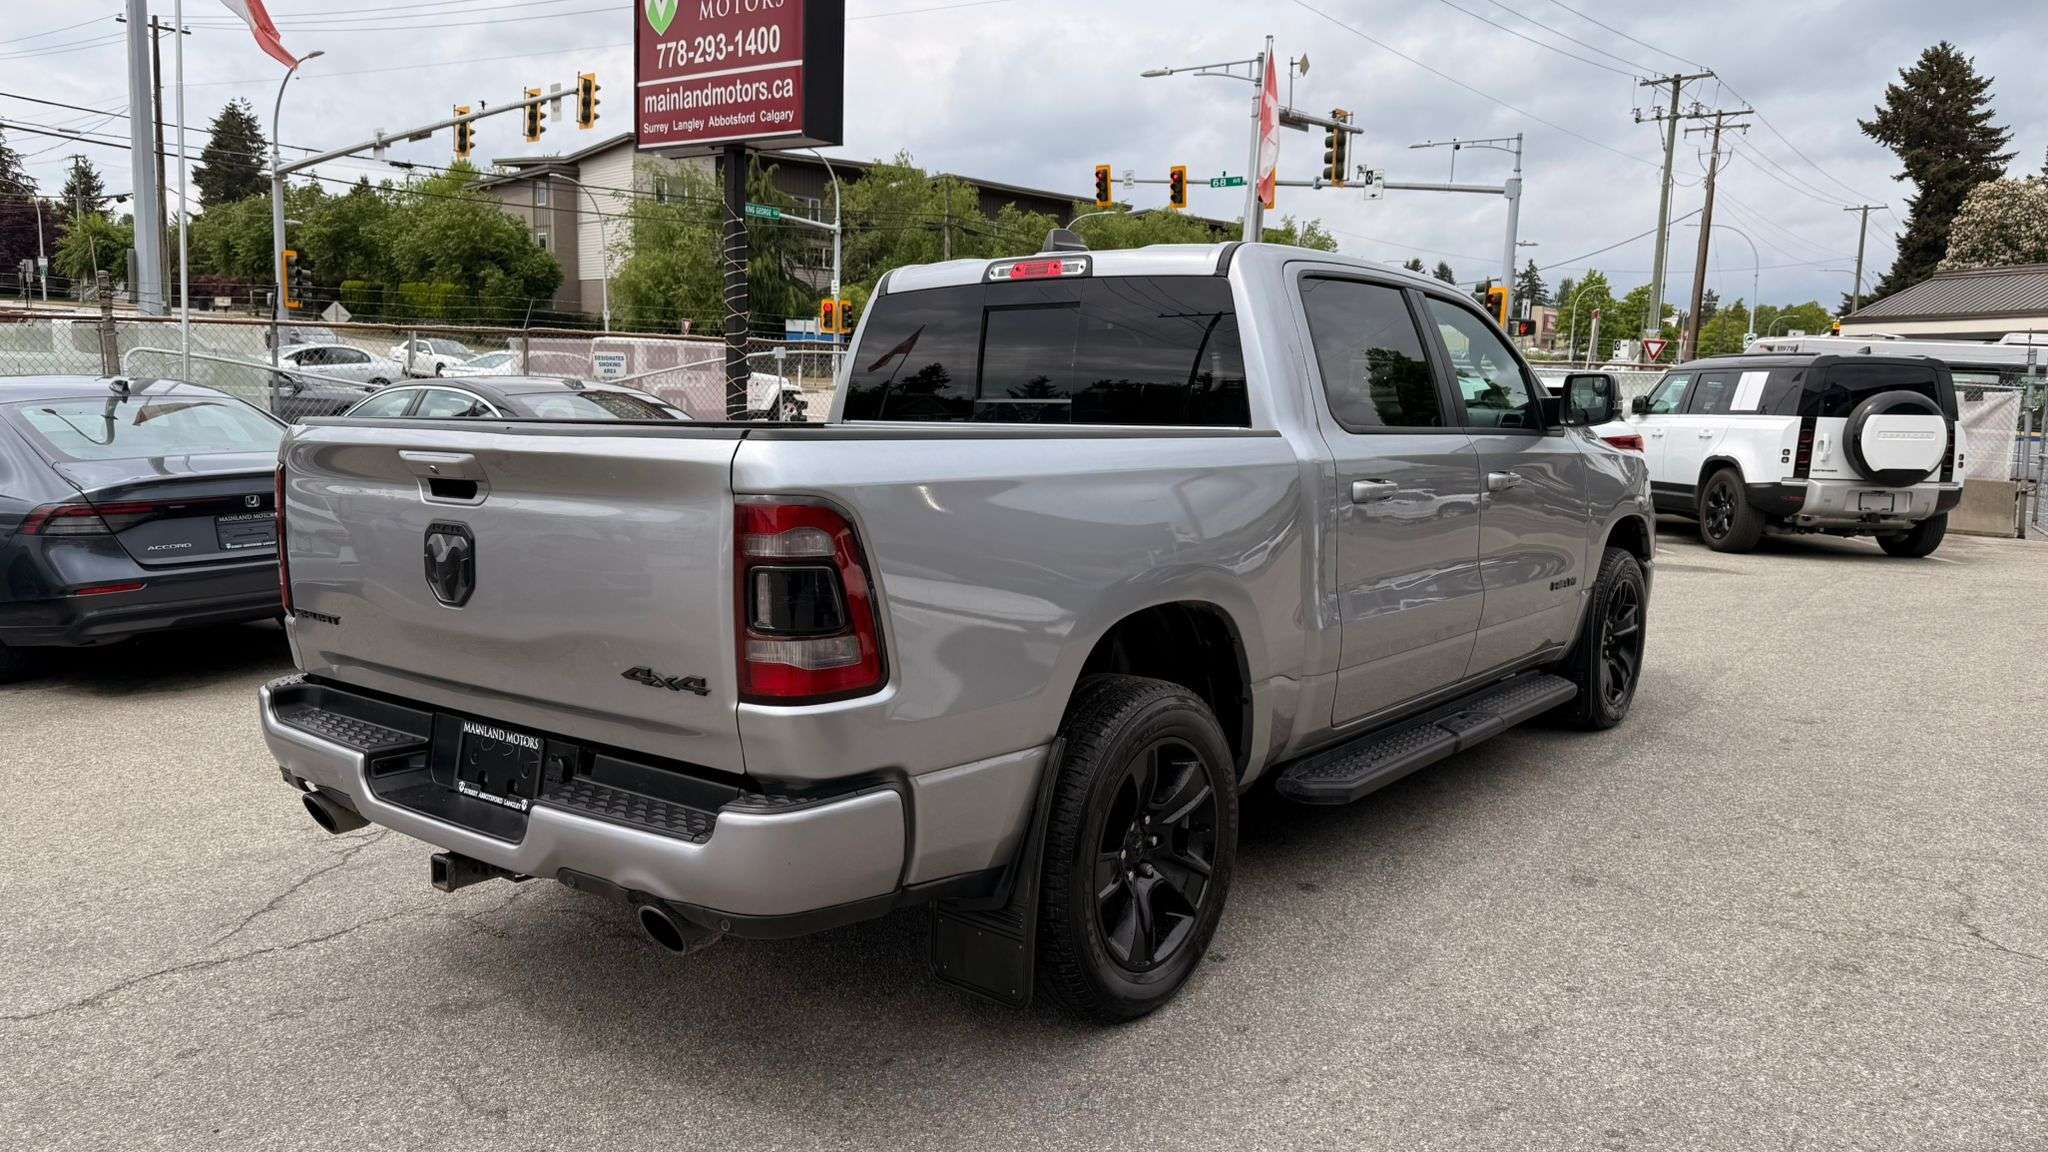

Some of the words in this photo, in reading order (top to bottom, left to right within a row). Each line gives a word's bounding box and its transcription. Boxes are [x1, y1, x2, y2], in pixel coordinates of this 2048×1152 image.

[656, 24, 781, 69] 778-293-1400
[644, 78, 794, 114] mainlandmotors.ca
[643, 121, 669, 135] Surrey
[672, 117, 705, 132] Langley
[708, 111, 756, 128] Abbotsford
[759, 109, 794, 124] Calgary
[1212, 178, 1226, 187] 68
[147, 542, 192, 551] ACCORD
[463, 722, 504, 740] MAINLAND
[506, 731, 538, 749] MOTORS
